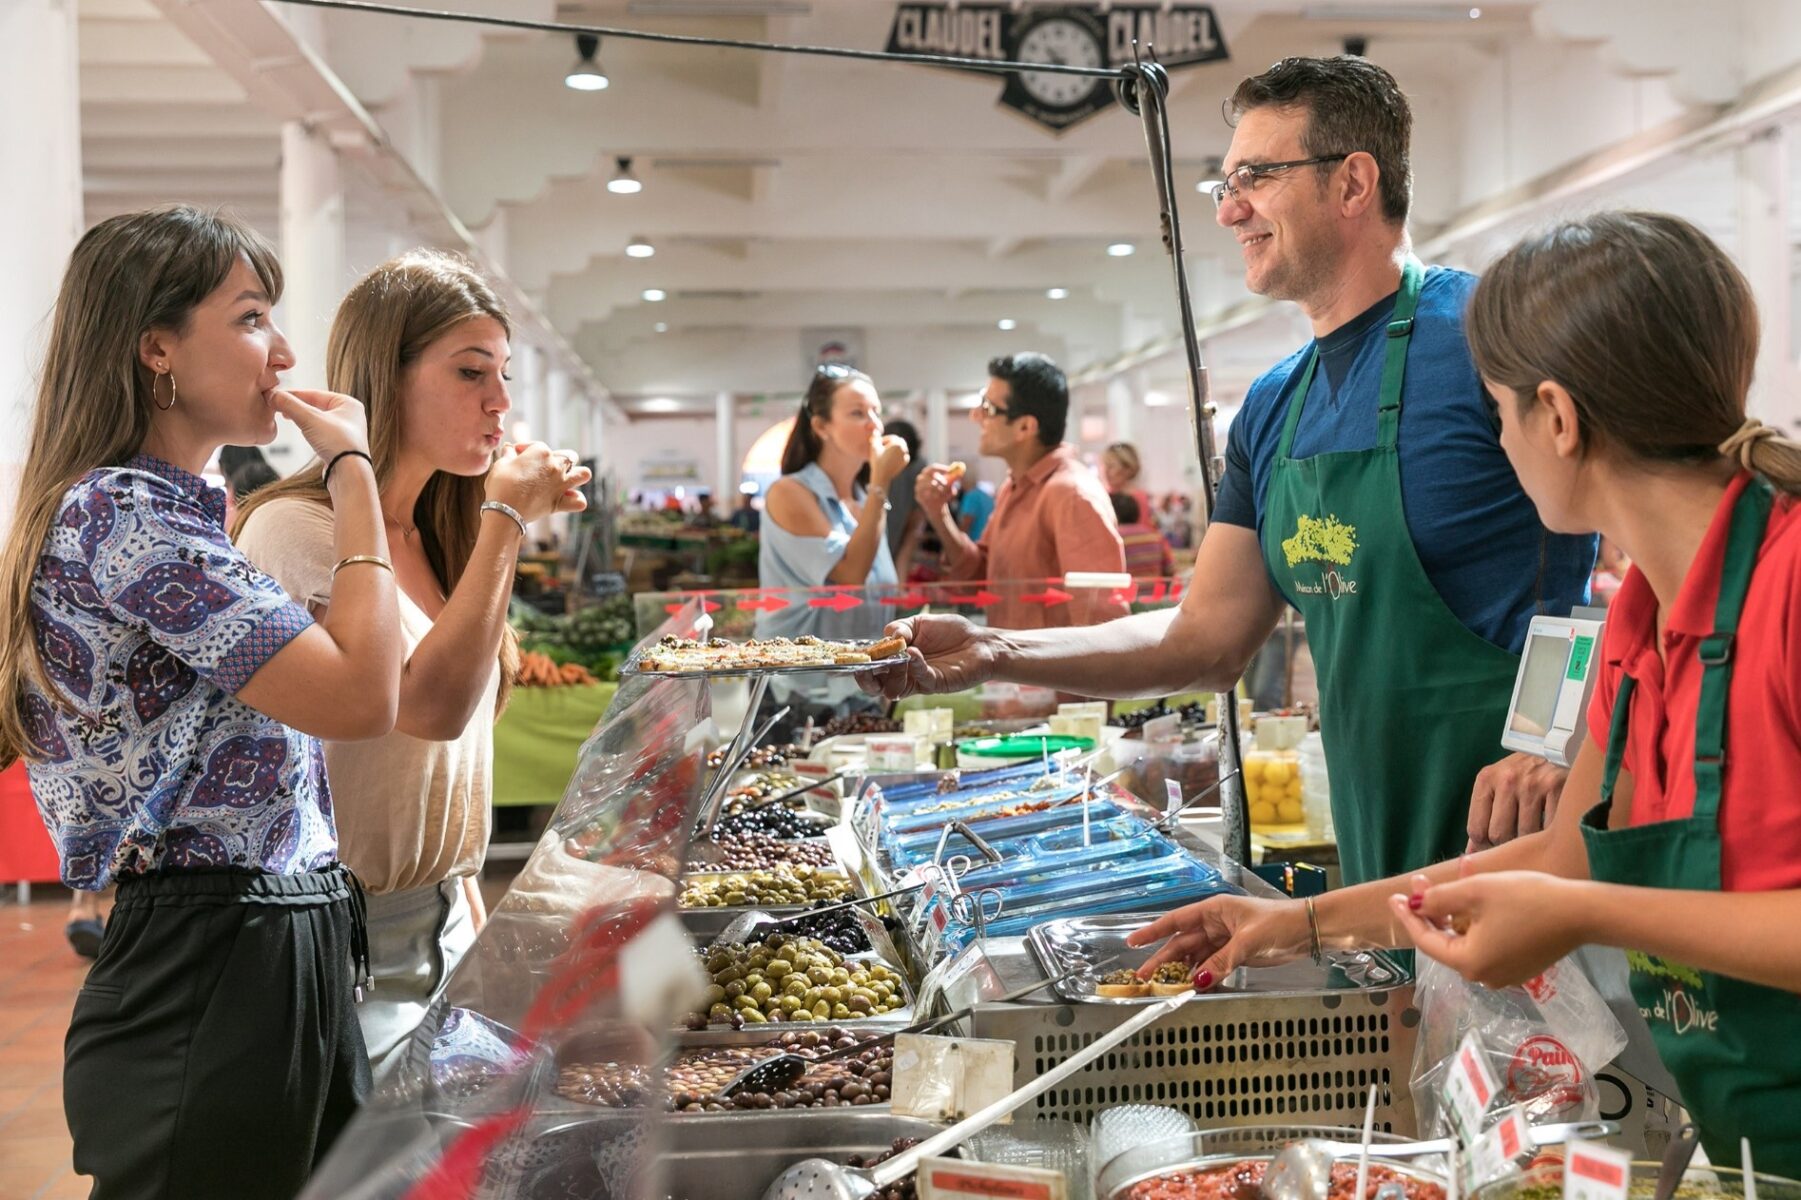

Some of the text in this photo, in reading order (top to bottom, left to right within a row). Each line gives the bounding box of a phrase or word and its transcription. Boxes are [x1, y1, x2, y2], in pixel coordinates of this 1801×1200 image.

[898, 8, 1007, 59] CLAUDEL
[1108, 10, 1217, 60] CLAUDEL
[1662, 988, 1719, 1034] l'Olive
